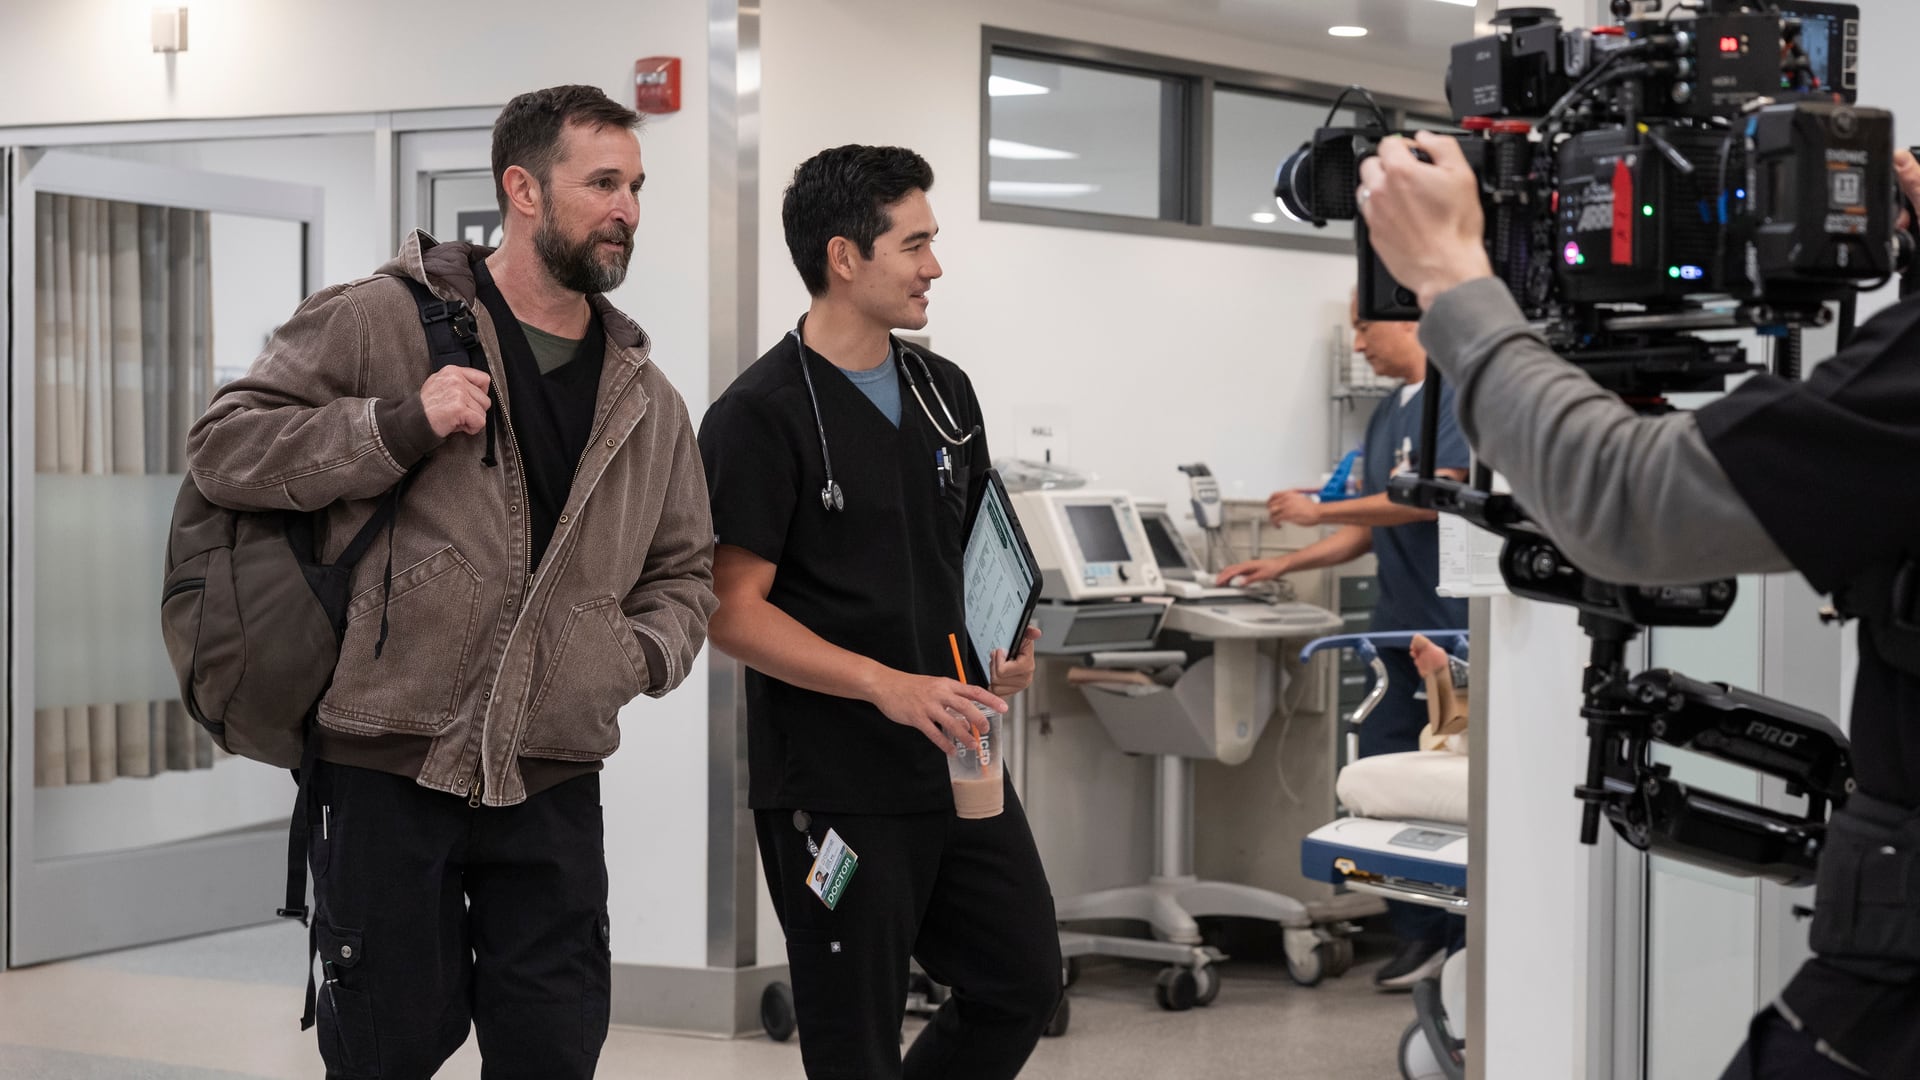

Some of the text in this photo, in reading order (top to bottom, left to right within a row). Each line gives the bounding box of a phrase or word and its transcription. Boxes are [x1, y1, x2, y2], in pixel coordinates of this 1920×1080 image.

[1745, 721, 1799, 748] PRO
[979, 735, 991, 766] ICED
[827, 857, 852, 904] DOCTOR
